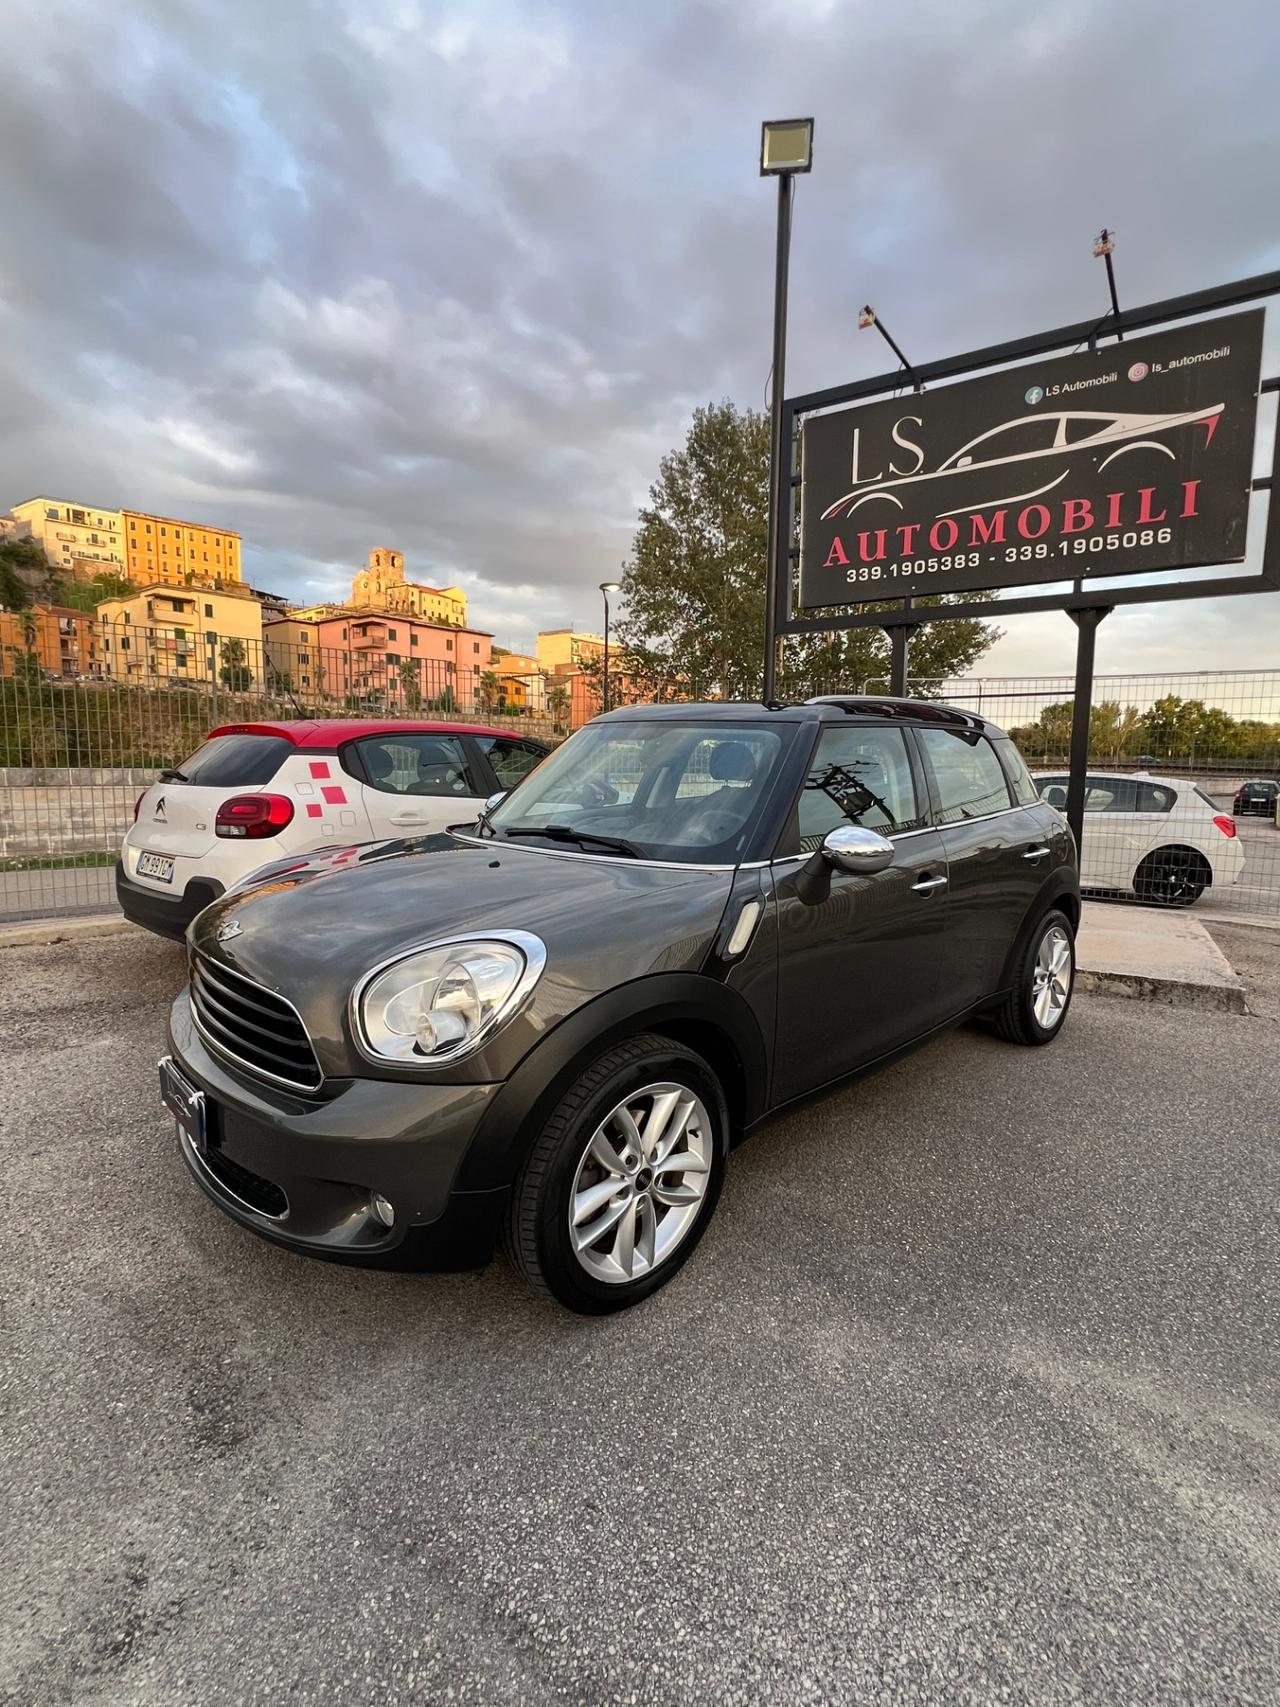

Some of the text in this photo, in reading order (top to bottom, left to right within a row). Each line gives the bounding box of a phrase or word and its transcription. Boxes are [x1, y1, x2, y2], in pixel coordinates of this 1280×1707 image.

[1045, 371, 1118, 397] LS Automobili
[852, 416, 925, 485] LS
[823, 480, 1201, 567] AUTOMOBILI
[846, 552, 980, 583] 339.1905383
[1005, 527, 1173, 563] 339.1905086
